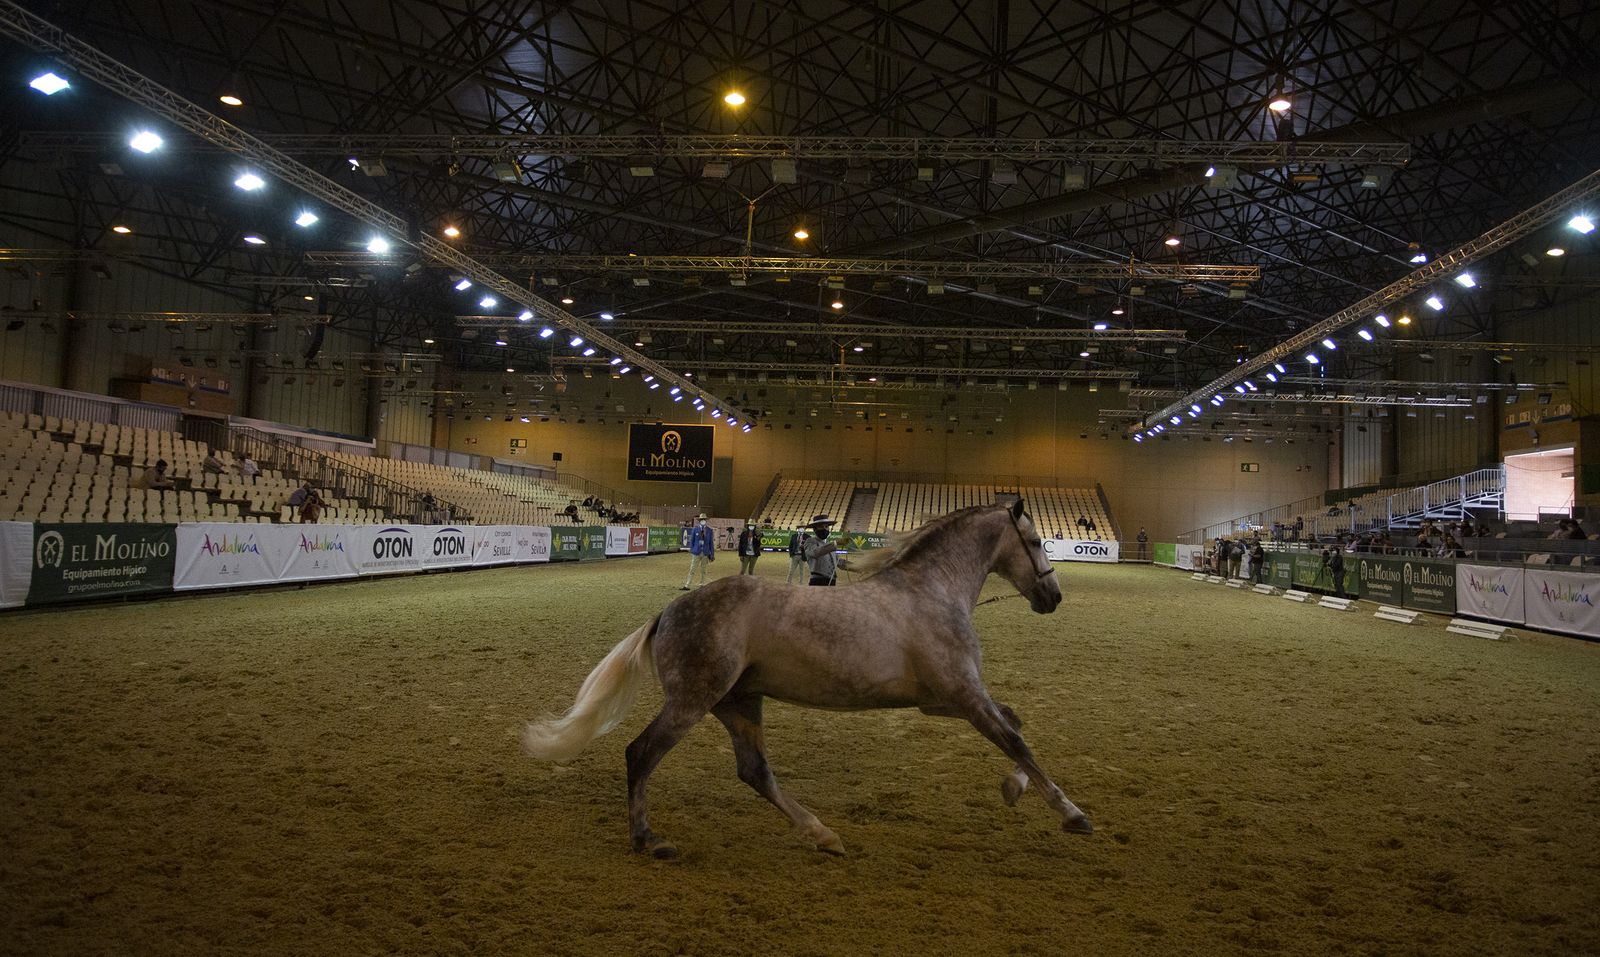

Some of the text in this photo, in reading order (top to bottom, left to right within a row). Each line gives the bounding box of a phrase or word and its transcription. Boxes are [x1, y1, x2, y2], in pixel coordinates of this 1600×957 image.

[635, 458, 647, 467] EL
[200, 533, 260, 556] Andalucía
[299, 532, 344, 554] Andalucía
[373, 537, 413, 559] OTON
[433, 536, 465, 556] OTON
[1074, 545, 1108, 555] OTON
[72, 545, 89, 561] EL
[63, 567, 121, 580] Equipamiento
[1368, 569, 1374, 578] EL
[1413, 572, 1420, 583] EL
[1470, 573, 1509, 597] Andalucía
[1542, 580, 1594, 607] Andalucía
